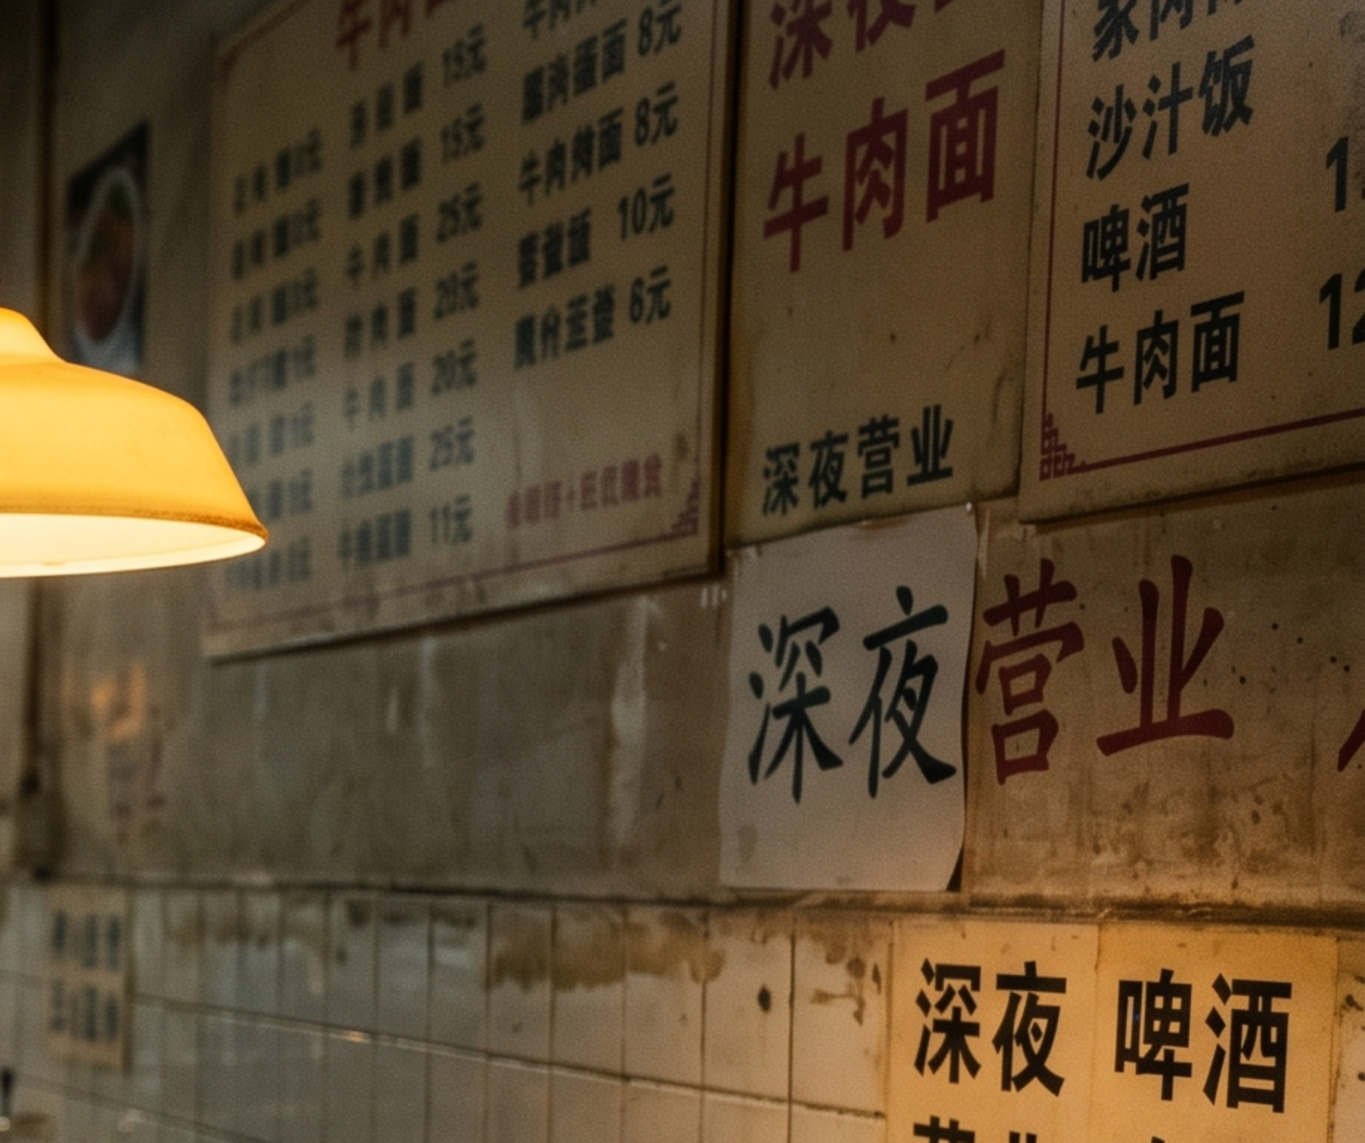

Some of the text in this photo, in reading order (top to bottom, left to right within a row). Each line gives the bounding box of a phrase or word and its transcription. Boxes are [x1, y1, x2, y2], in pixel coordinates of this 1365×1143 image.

[635, 82, 677, 147] 8元
[763, 48, 1006, 274] 牛肉面
[1086, 34, 1365, 213] 沙汁饭 1
[617, 173, 676, 242] 10元
[1080, 182, 1191, 294] 啤酒
[629, 264, 671, 325] 6元
[1075, 291, 1245, 415] 牛肉面
[762, 403, 954, 517] 深夜营业
[748, 585, 957, 804] 深夜
[975, 555, 1235, 786] 营业
[914, 958, 1067, 1097] 深夜
[1114, 968, 1293, 1114] 啤酒
